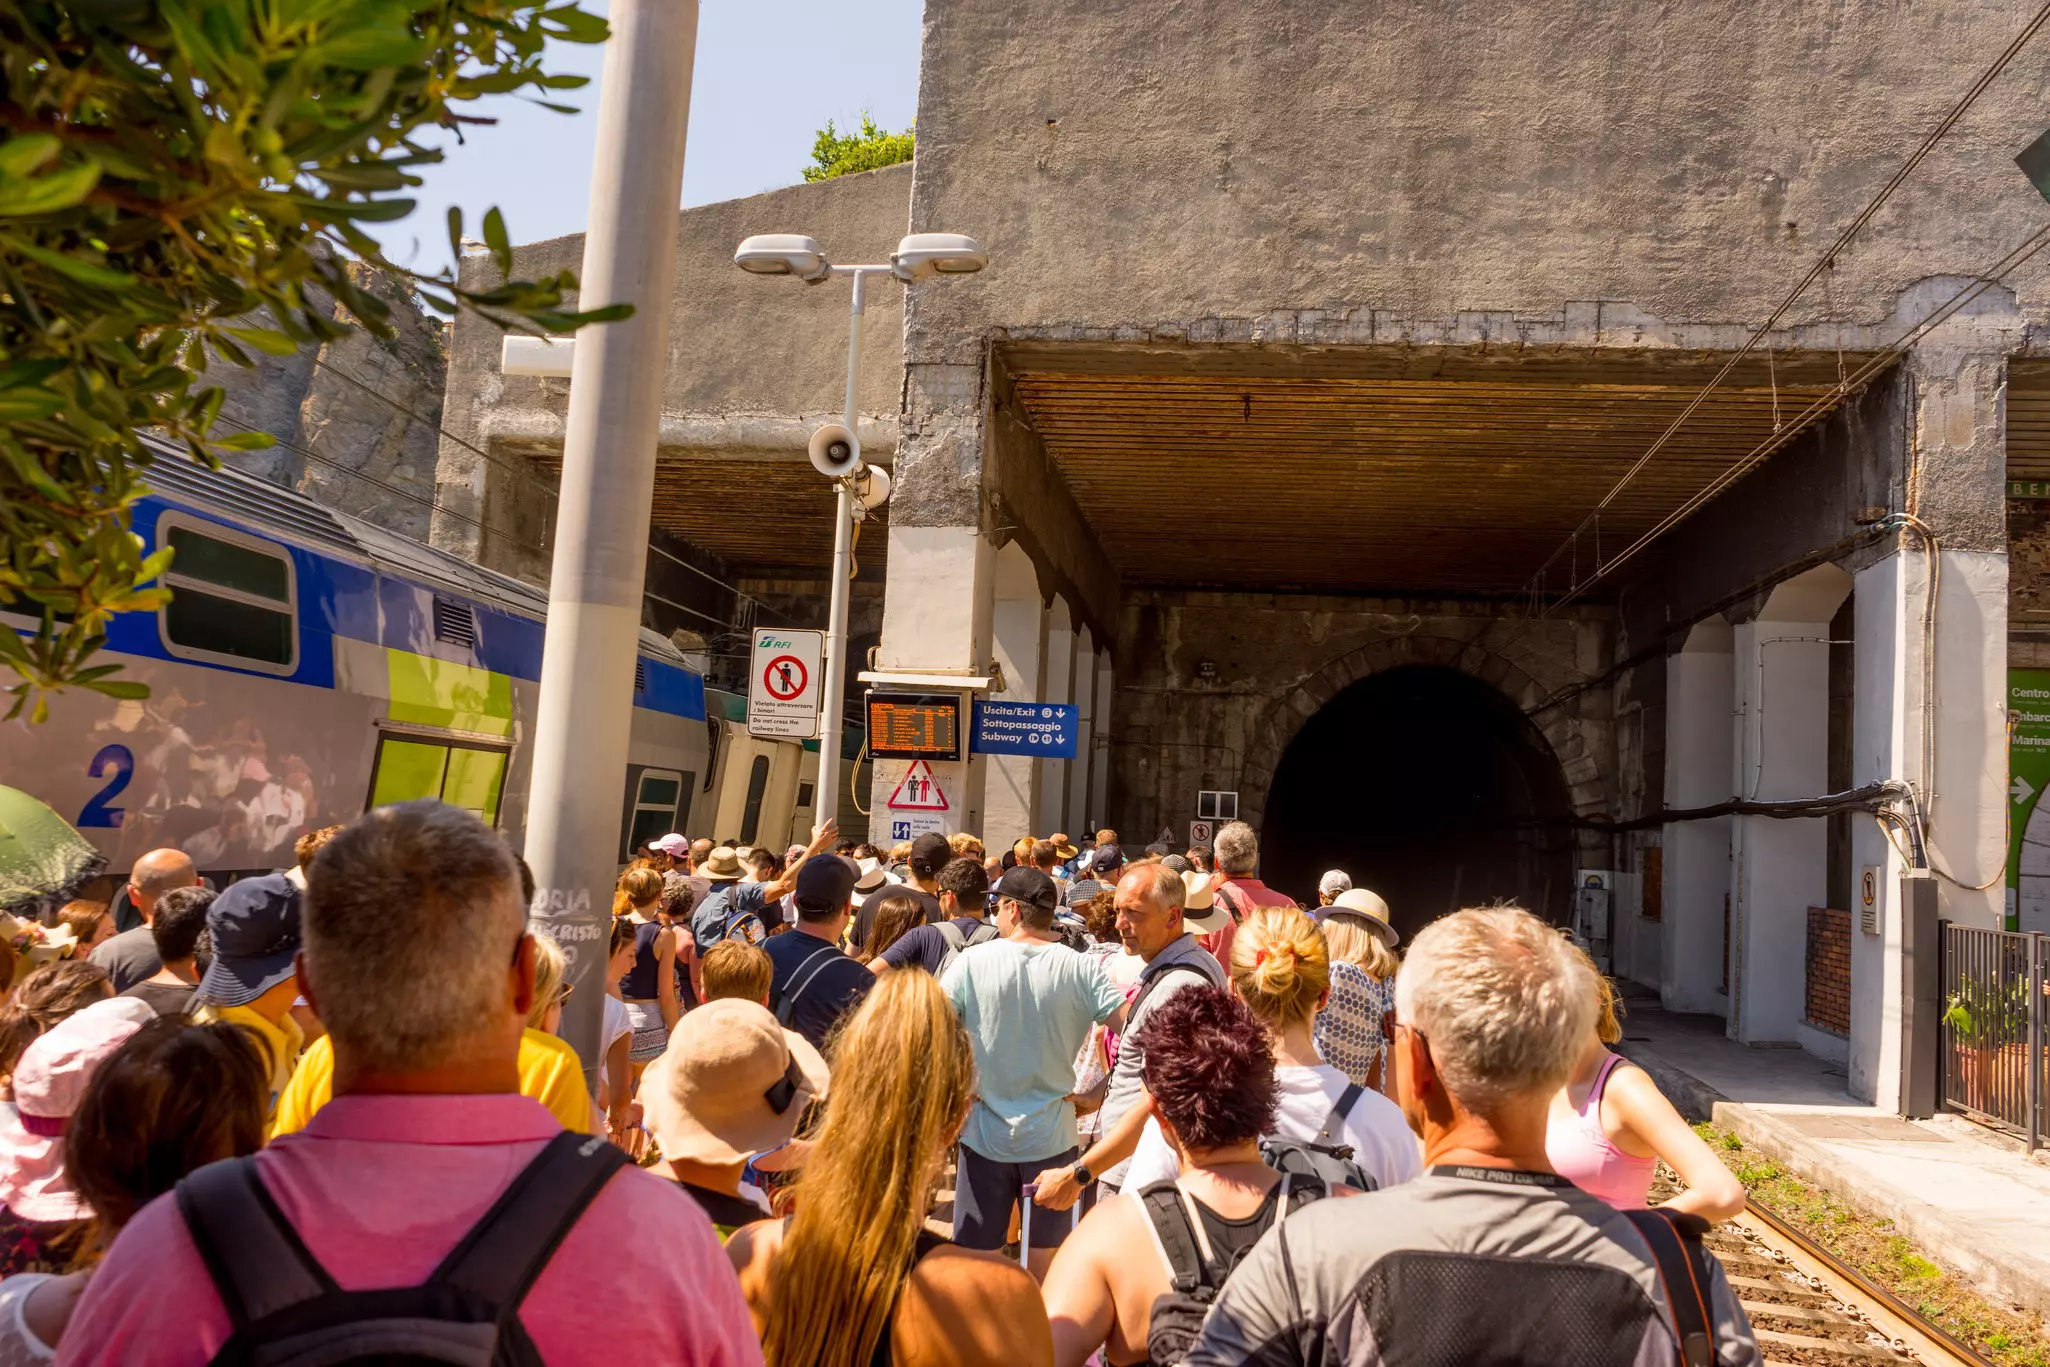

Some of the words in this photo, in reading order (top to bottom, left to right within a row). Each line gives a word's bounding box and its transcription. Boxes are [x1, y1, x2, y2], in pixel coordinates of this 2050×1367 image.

[773, 641, 792, 649] RFI
[2011, 687, 2050, 698] Centro
[983, 705, 1036, 717] Uscita/Exit
[2020, 711, 2050, 722] mbarc
[982, 718, 1061, 732] Sottopassaggio
[981, 731, 1023, 744] Subway
[2012, 735, 2050, 746] Marina
[76, 743, 135, 828] 2
[1455, 1166, 1487, 1180] NIKE
[1487, 1170, 1514, 1182] PRO
